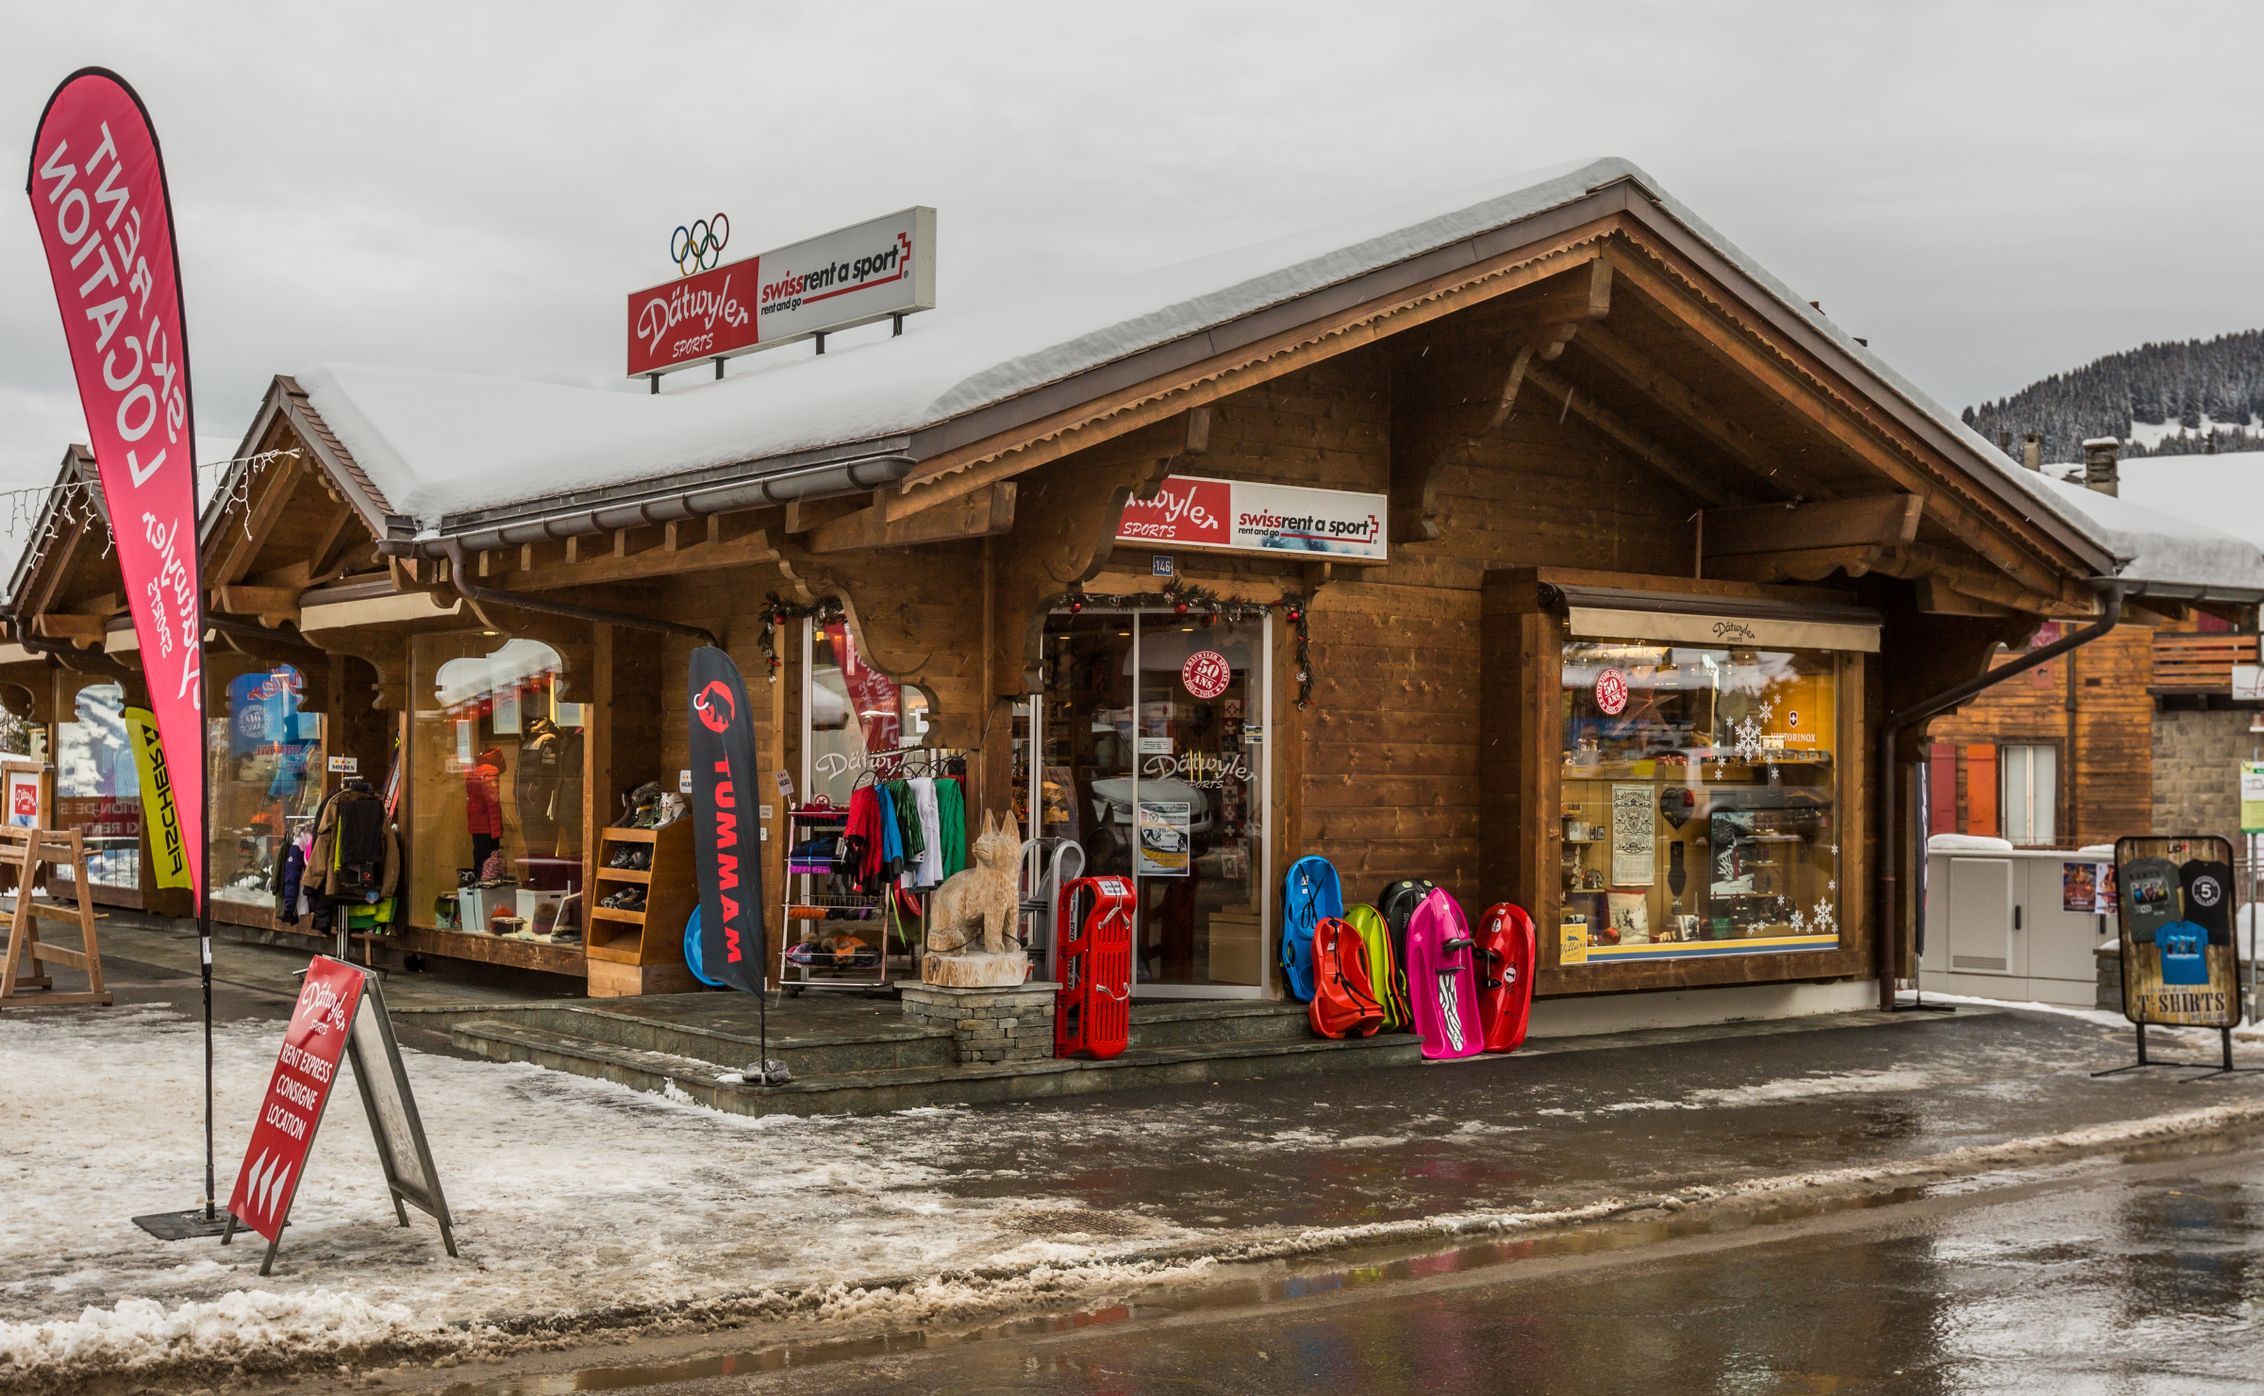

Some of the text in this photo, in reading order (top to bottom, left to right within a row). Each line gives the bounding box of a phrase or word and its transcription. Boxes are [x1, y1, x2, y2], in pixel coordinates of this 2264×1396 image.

[838, 264, 850, 283] a
[851, 243, 900, 283] sport
[636, 273, 749, 357] Dätwyler
[760, 297, 802, 317] rent and go
[672, 332, 714, 358] SPORTS
[1122, 522, 1177, 538] SPORTS
[1238, 527, 1280, 539] rent and go
[1315, 519, 1326, 532] a
[1328, 517, 1370, 537] sport
[1155, 560, 1171, 573] 146
[1712, 621, 1756, 640] Dätwyler
[1197, 658, 1220, 678] 50
[1192, 675, 1214, 689] ANS
[1603, 678, 1618, 695] 50
[1607, 691, 1621, 705] ANS
[1143, 749, 1258, 782] Dätwyler
[1184, 779, 1224, 790] SPORTS
[2200, 884, 2212, 898] 5
[301, 980, 346, 1032] Dätwyler
[310, 1020, 328, 1036] SPORTS
[280, 1043, 334, 1084] RENT EXPRESS
[275, 1073, 318, 1111] CONSIGNE
[265, 1102, 306, 1141] LOCATION
